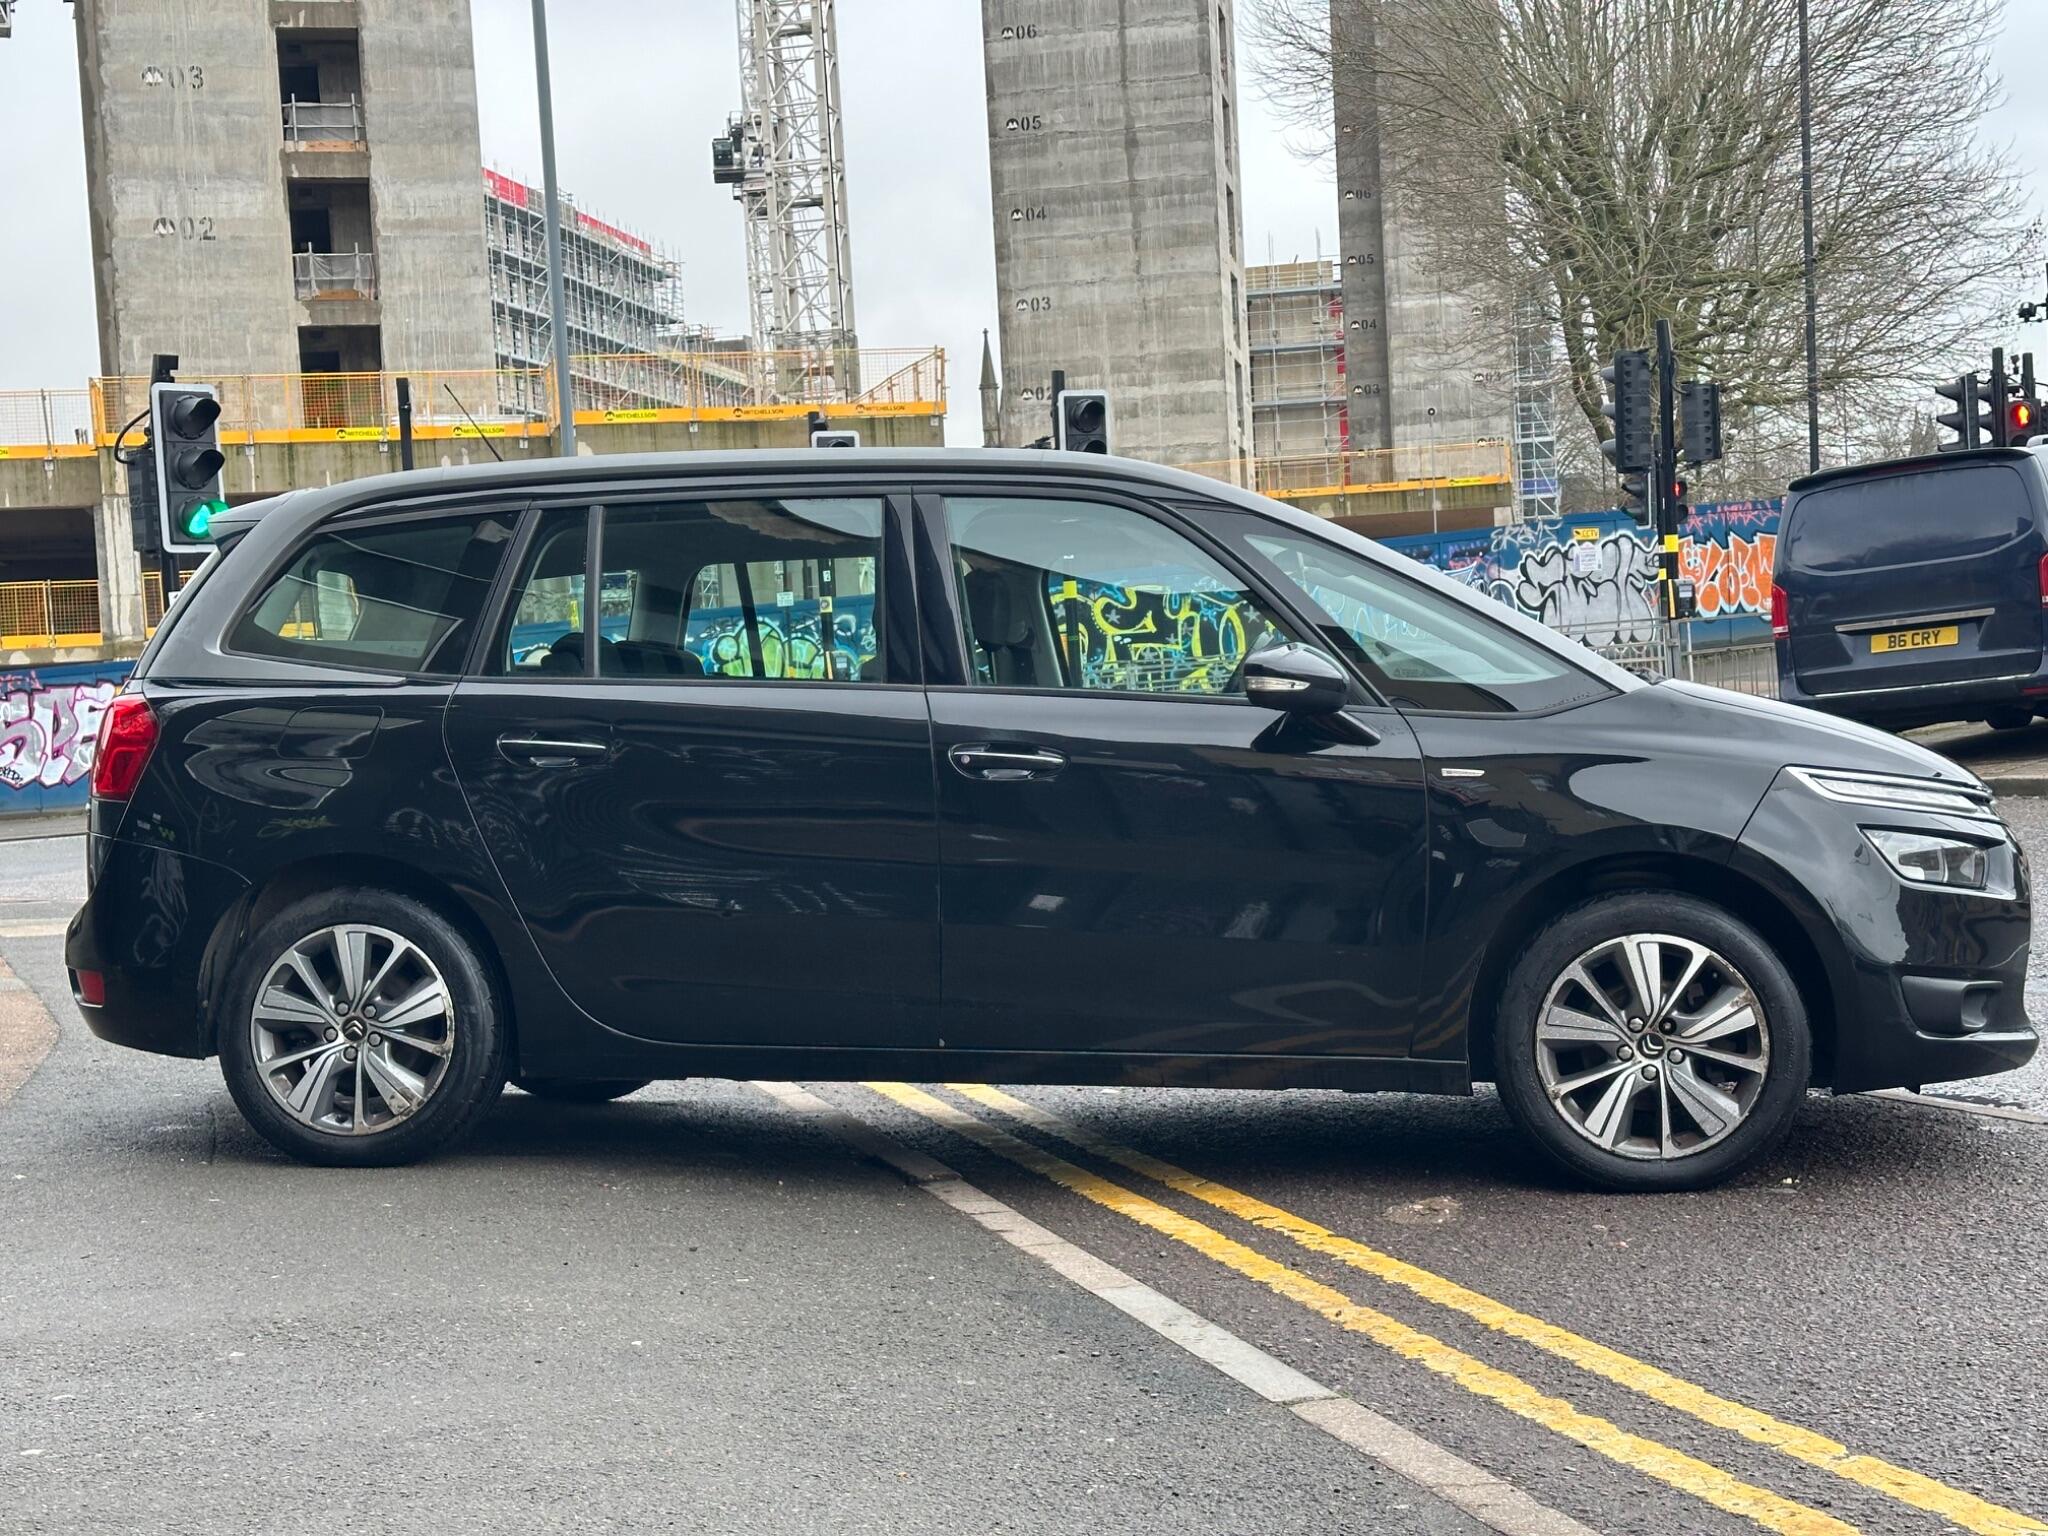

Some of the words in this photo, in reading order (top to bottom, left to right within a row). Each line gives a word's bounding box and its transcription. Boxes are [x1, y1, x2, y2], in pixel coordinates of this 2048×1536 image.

[1016, 24, 1037, 39] 06
[168, 65, 204, 89] 03
[1021, 115, 1041, 131] 05
[1026, 206, 1047, 221] 04
[179, 216, 216, 241] 02
[1358, 254, 1374, 264] 05
[1031, 297, 1051, 312] 03
[1361, 319, 1377, 330] 04
[1364, 384, 1380, 395] 03
[1888, 634, 1907, 649] B6
[1912, 630, 1941, 646] CRY
